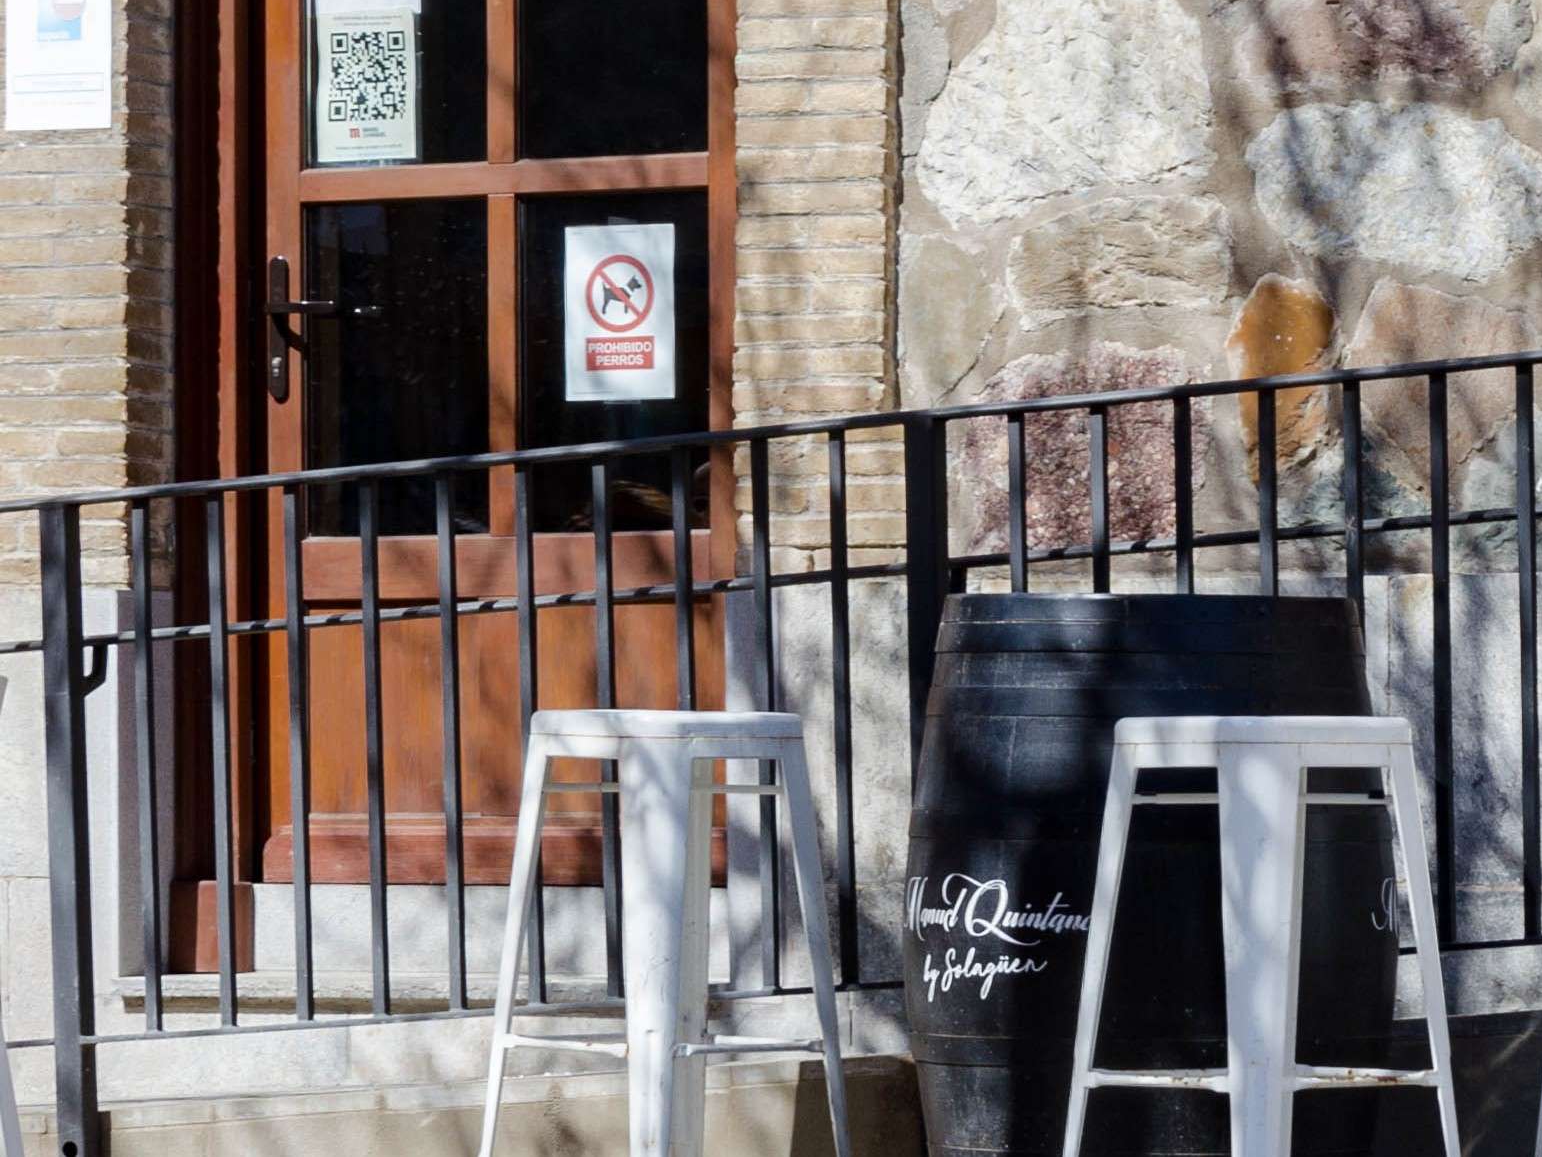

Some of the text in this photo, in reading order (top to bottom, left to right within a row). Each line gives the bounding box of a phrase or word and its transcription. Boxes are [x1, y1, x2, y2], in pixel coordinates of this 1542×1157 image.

[588, 341, 652, 354] PROHIBIDO
[596, 354, 645, 366] PERROS
[923, 954, 941, 1003] by
